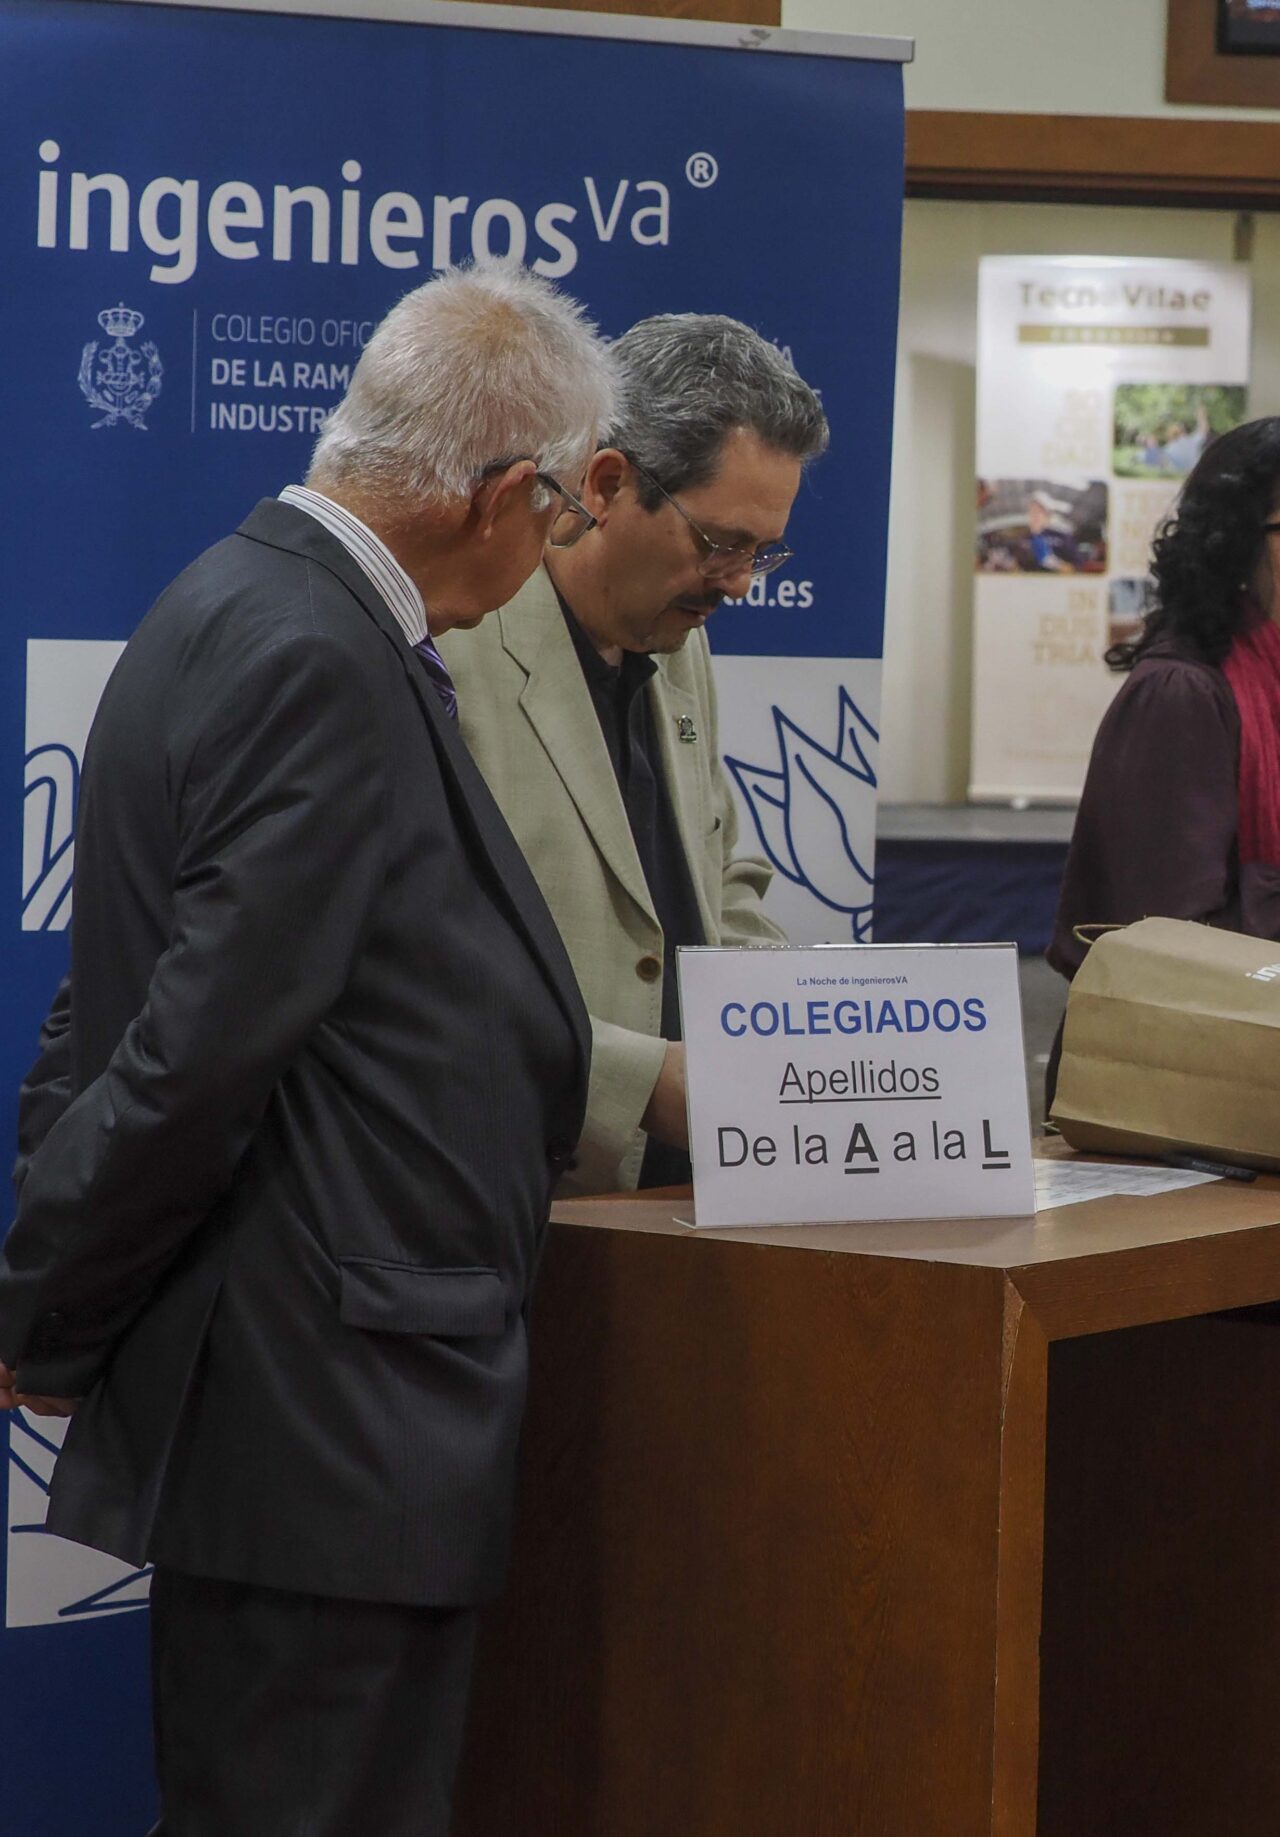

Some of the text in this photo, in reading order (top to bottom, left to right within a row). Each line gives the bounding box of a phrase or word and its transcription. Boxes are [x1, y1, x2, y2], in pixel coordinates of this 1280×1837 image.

[211, 313, 374, 348] COLEGIO OFIC
[211, 358, 352, 391] DE LA RAM
[210, 402, 331, 433] INDUSTR
[796, 977, 807, 986] La
[809, 976, 837, 986] Noche
[839, 976, 850, 986] de
[719, 998, 988, 1038] COLEGIADOS
[778, 1059, 941, 1104] Apellidos
[717, 1119, 1010, 1168] De la A a la L
